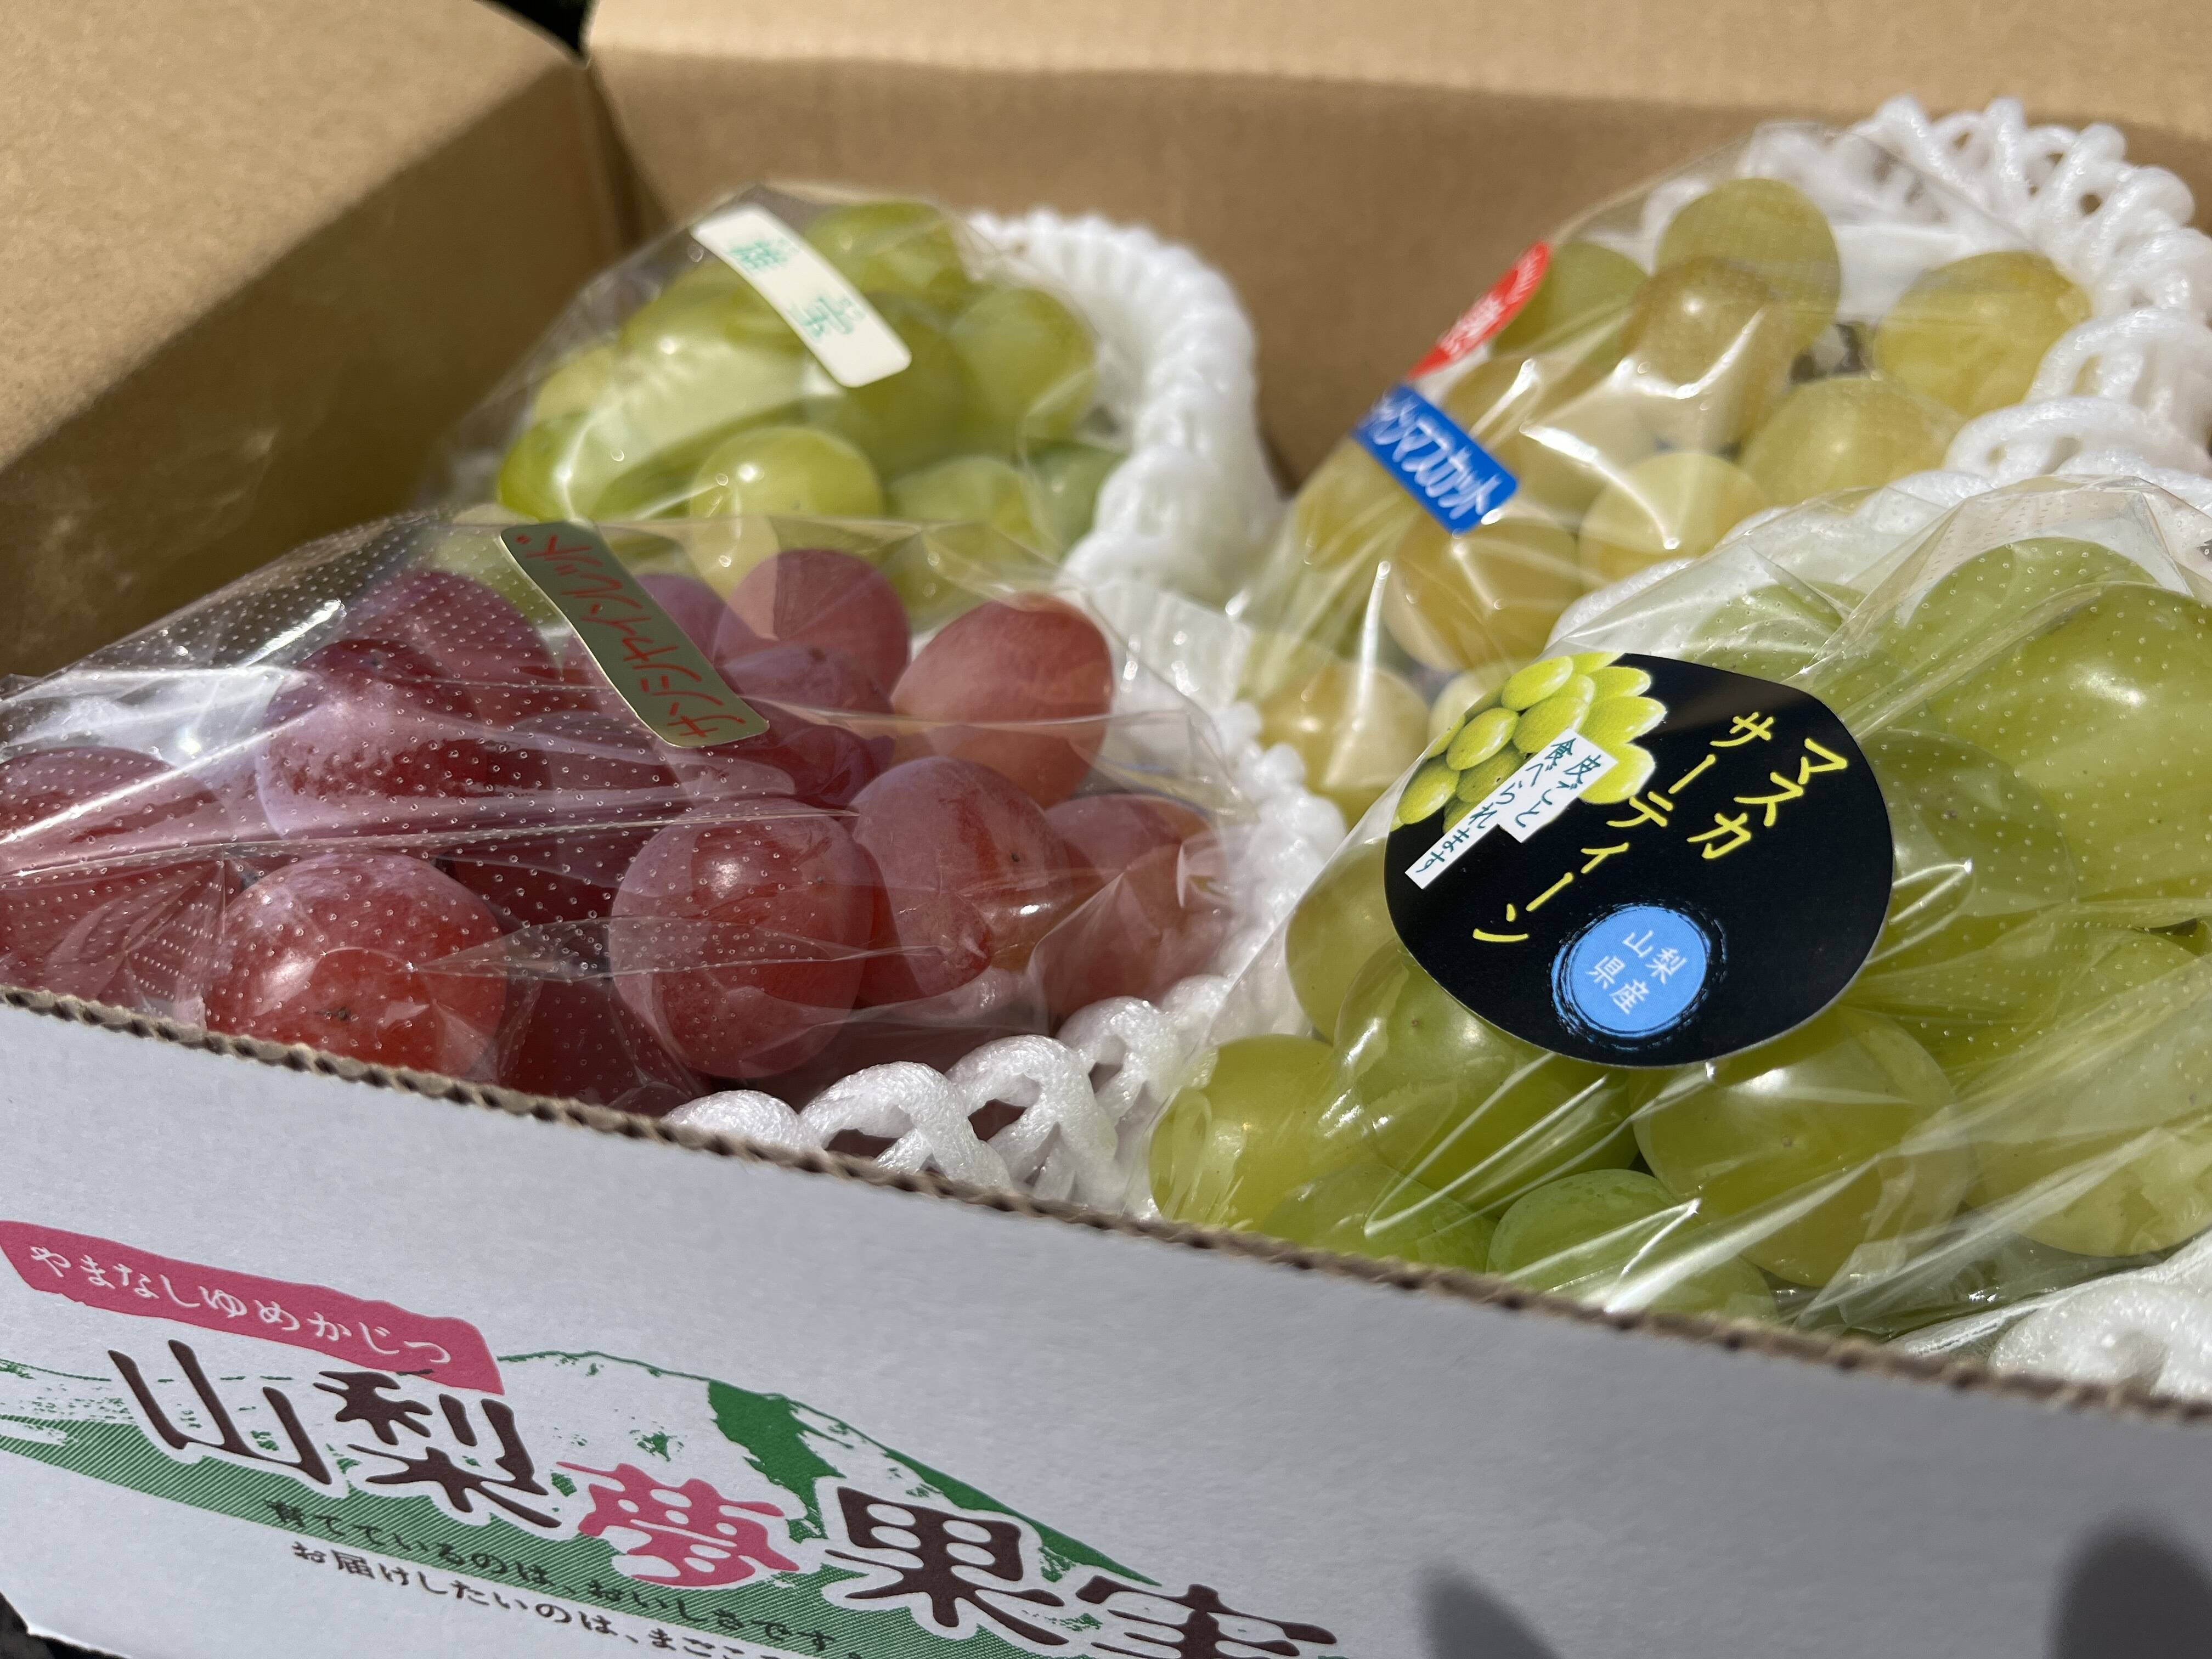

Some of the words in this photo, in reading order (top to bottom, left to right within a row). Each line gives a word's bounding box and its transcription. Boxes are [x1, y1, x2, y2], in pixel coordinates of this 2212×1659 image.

[515, 534, 747, 738] サンシャインレッド
[1415, 738, 1576, 873] 食べられます
[1473, 712, 1778, 943] サーティーン
[1515, 755, 1601, 828] 皮ごと
[1685, 737, 1850, 860] マスカ
[30, 1245, 452, 1364] やまなしゆめかじつ
